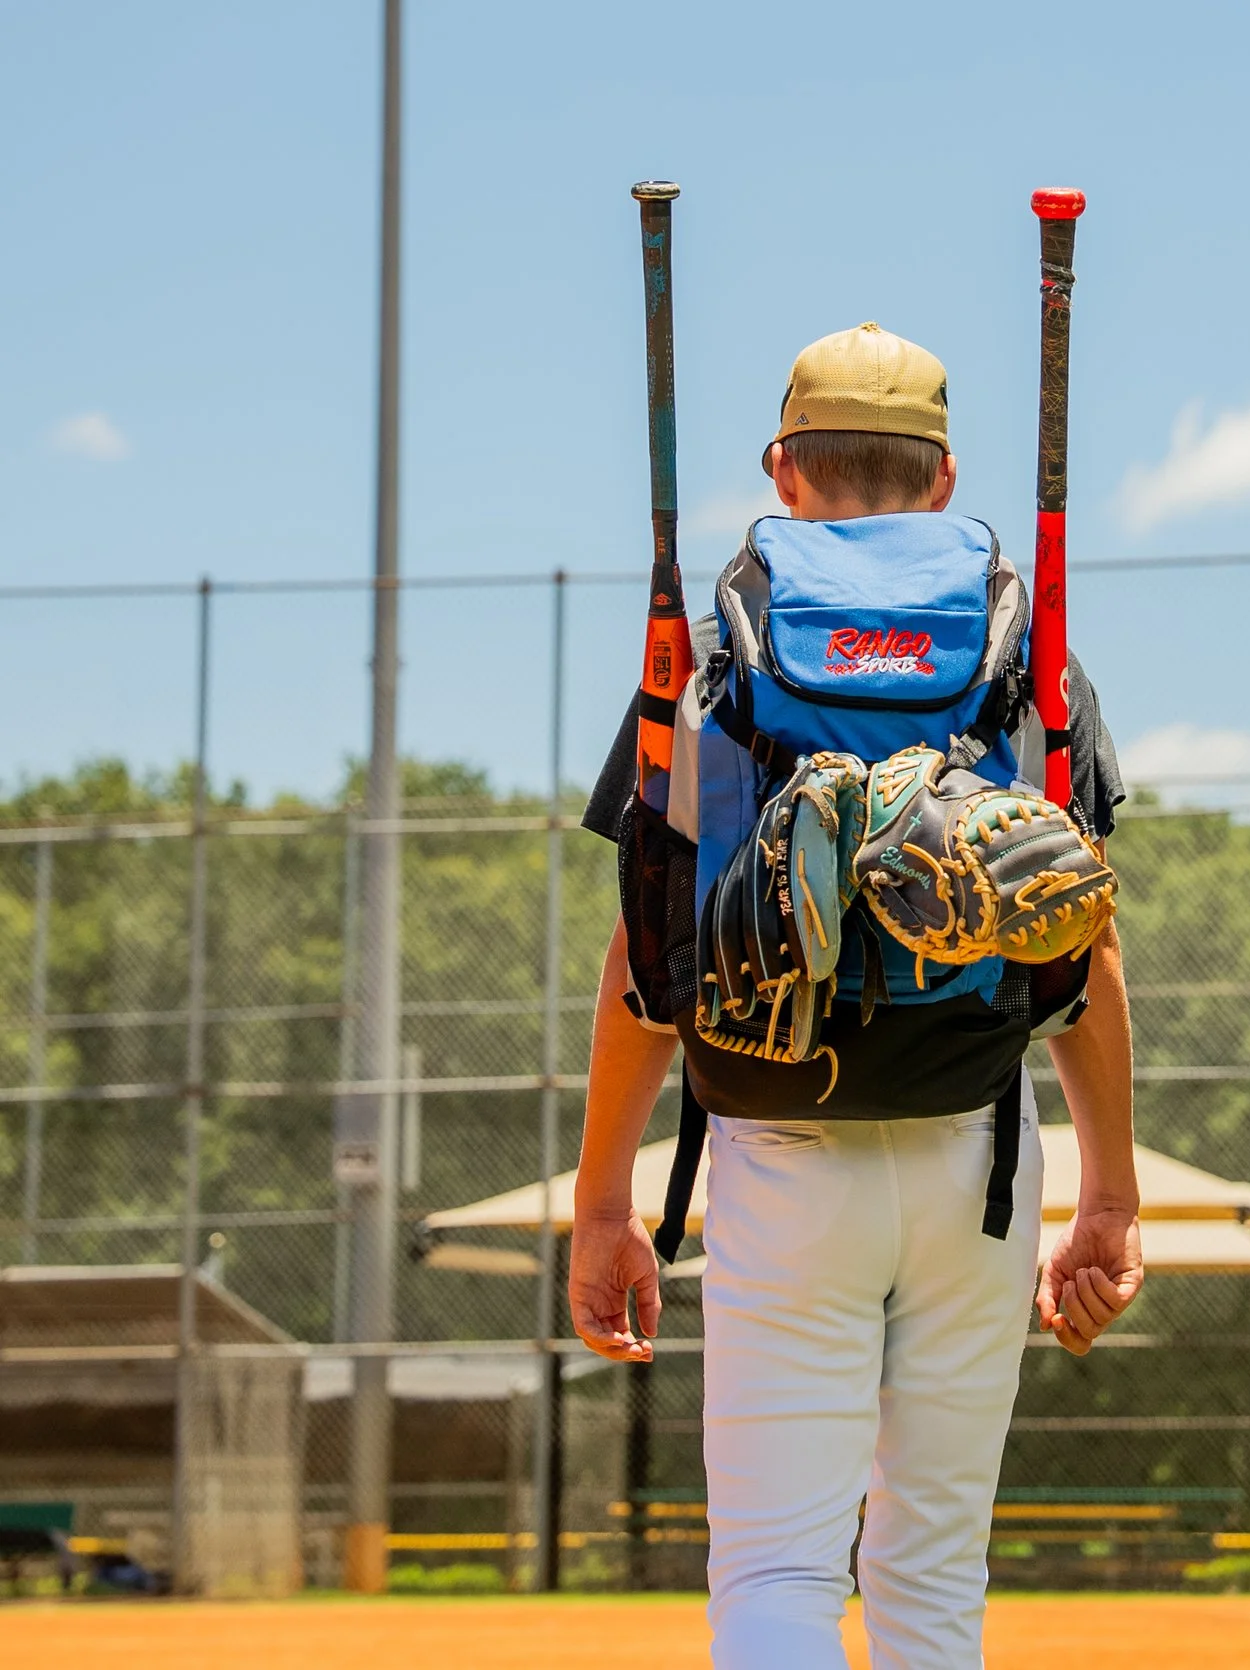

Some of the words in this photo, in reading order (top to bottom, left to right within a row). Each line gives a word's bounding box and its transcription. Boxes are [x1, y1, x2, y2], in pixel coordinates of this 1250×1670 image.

[826, 627, 932, 660] RANGO
[853, 656, 919, 675] SPORTS
[880, 846, 931, 890] Edmonds
